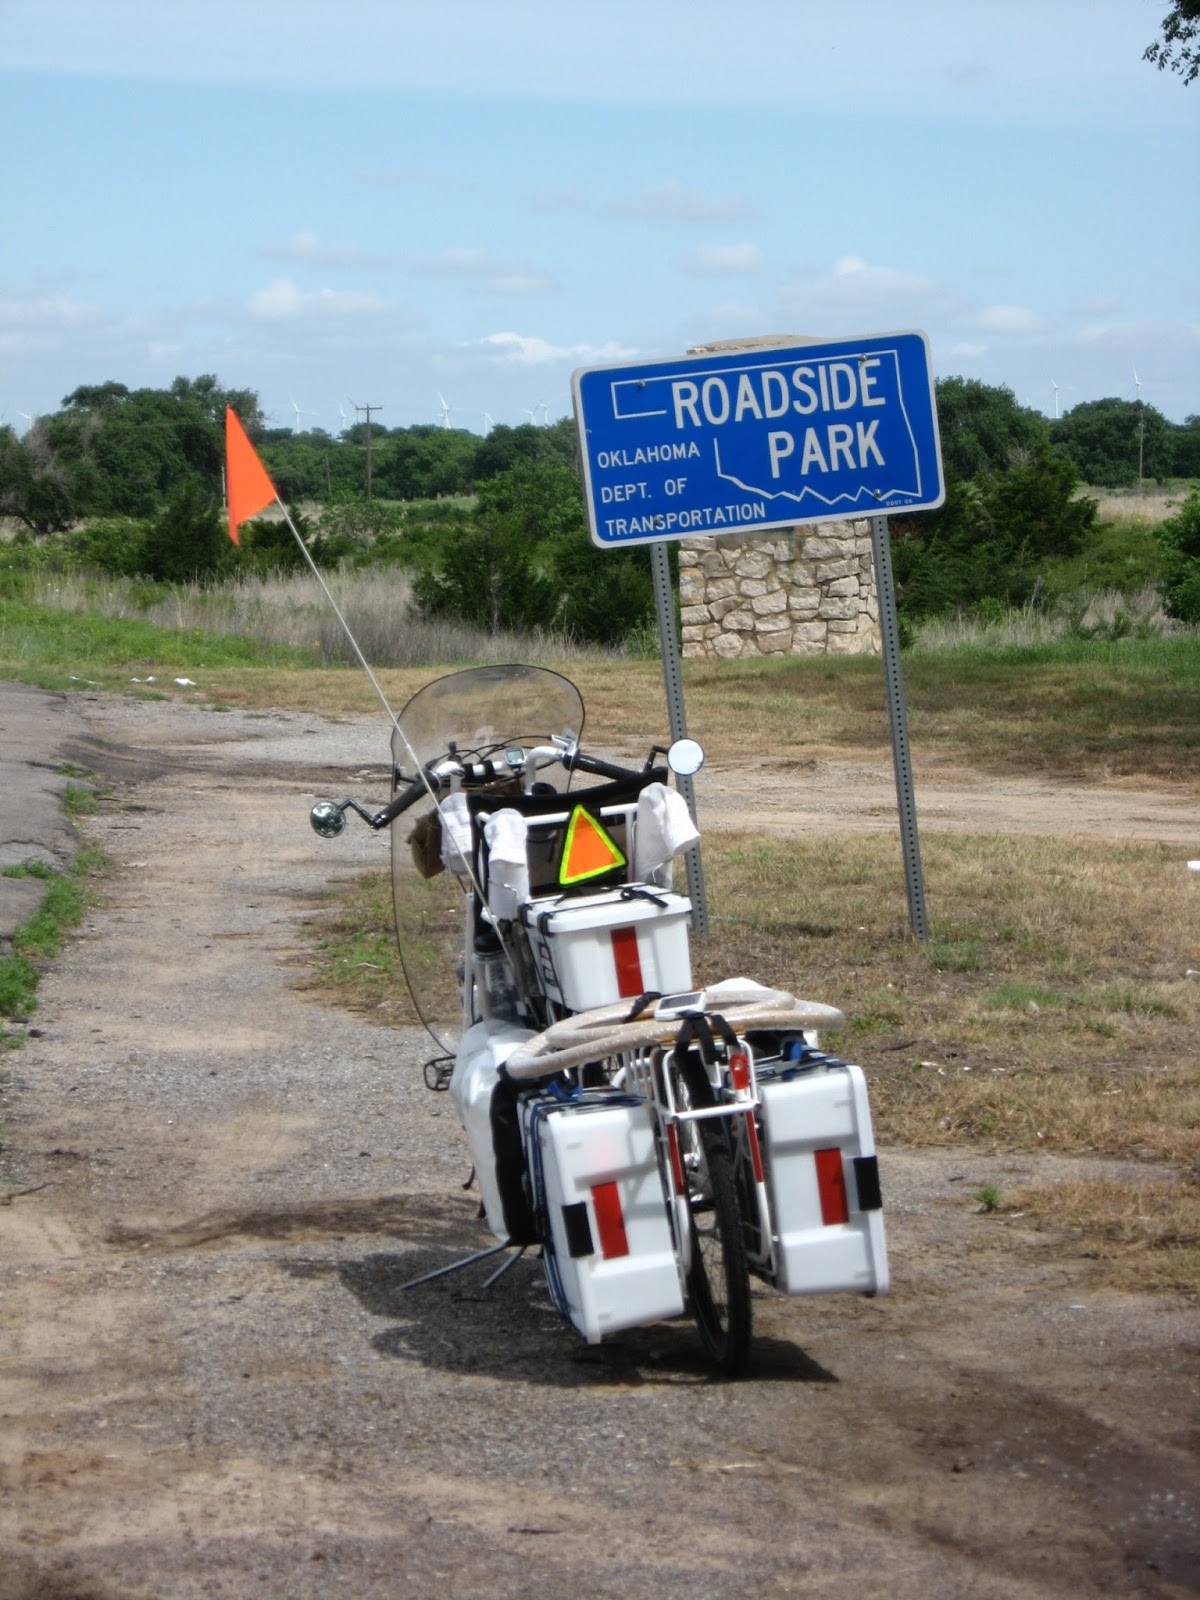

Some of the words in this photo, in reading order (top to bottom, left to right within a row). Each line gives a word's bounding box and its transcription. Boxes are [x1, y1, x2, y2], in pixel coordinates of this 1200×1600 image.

[671, 358, 886, 429] ROADSIDE
[597, 441, 701, 469] OKLAHOMA
[767, 419, 886, 479] PARK
[601, 482, 652, 504] DEPT.
[664, 477, 687, 496] OF
[605, 502, 766, 537] TRANSPORTATION
